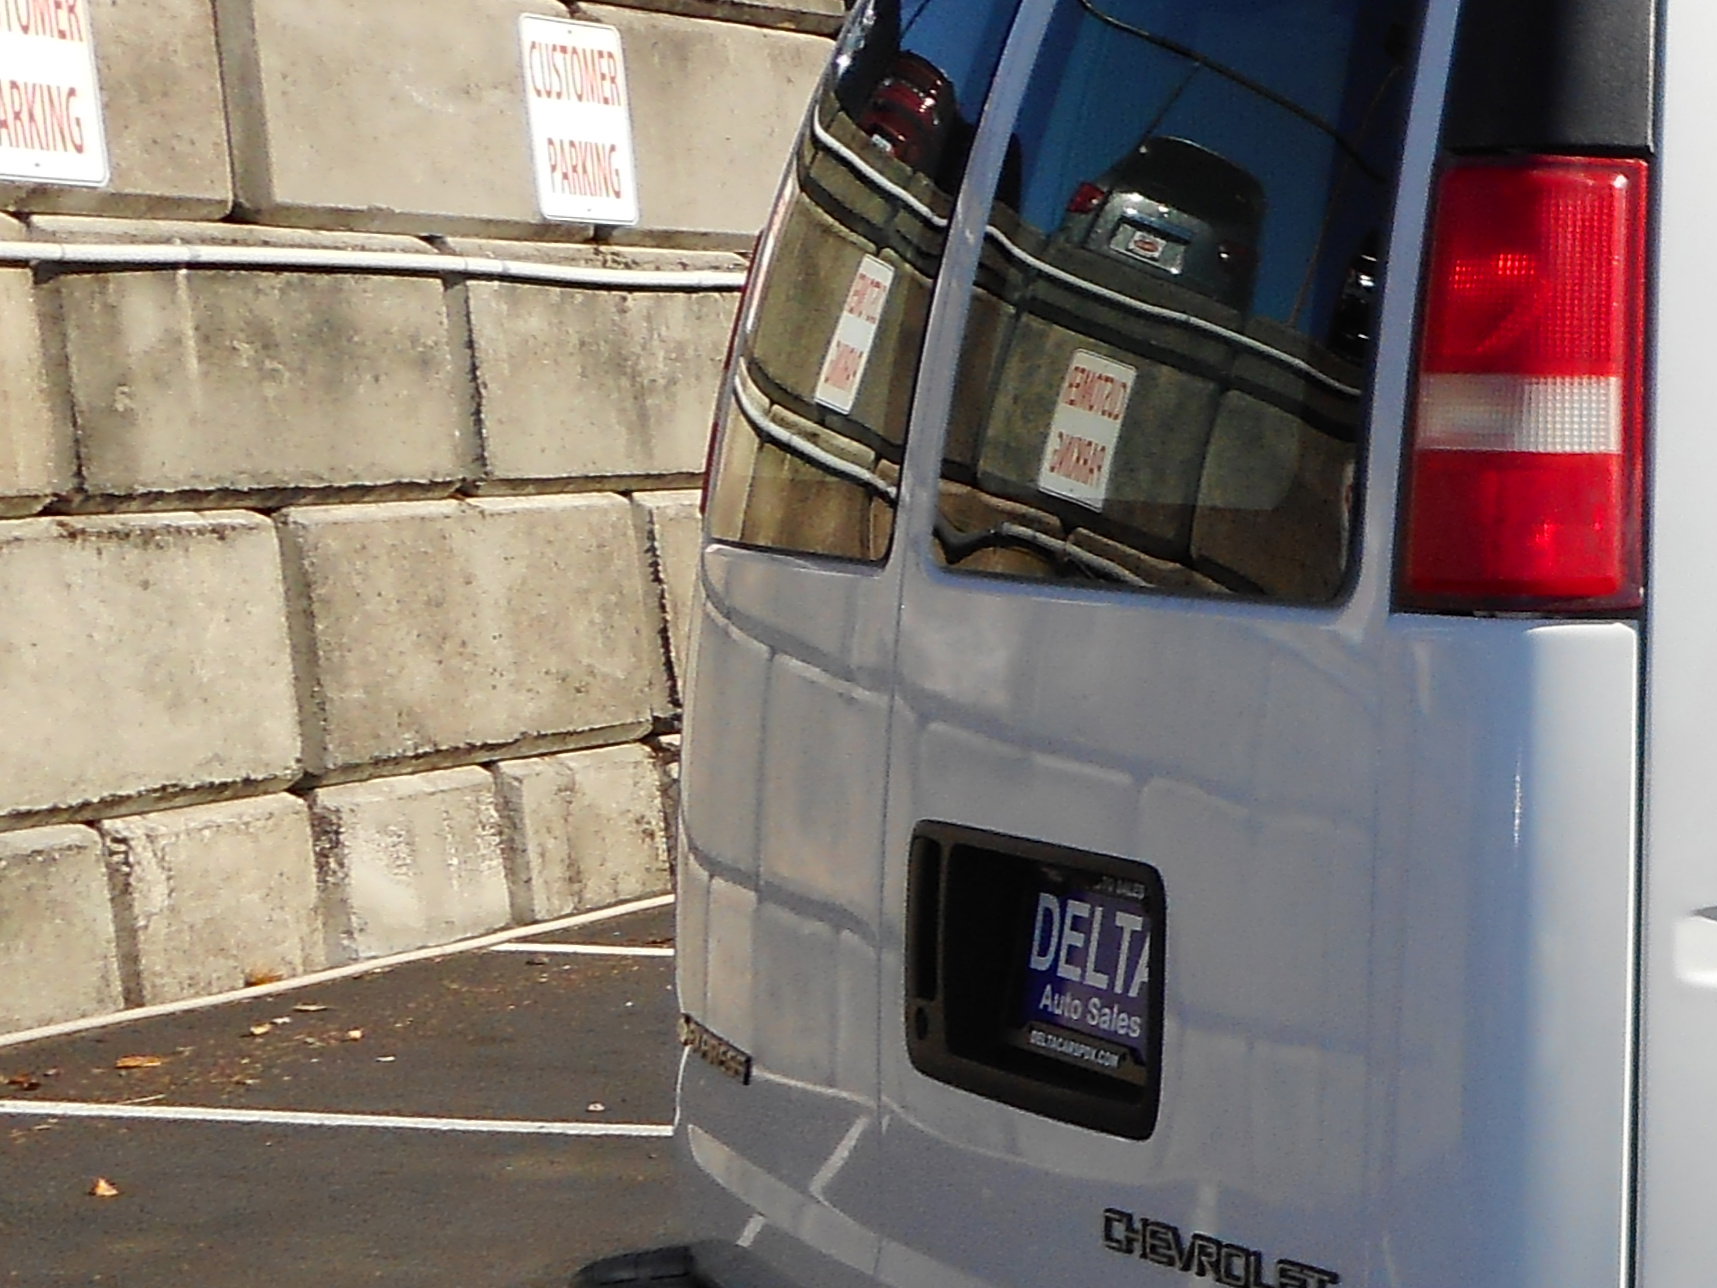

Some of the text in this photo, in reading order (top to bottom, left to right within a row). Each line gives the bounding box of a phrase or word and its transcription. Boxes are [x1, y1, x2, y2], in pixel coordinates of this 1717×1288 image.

[528, 40, 622, 107] CUSTOMER
[546, 137, 621, 200] PARKING
[1028, 891, 1151, 998] DELTA
[1038, 983, 1142, 1039] Auto Sales
